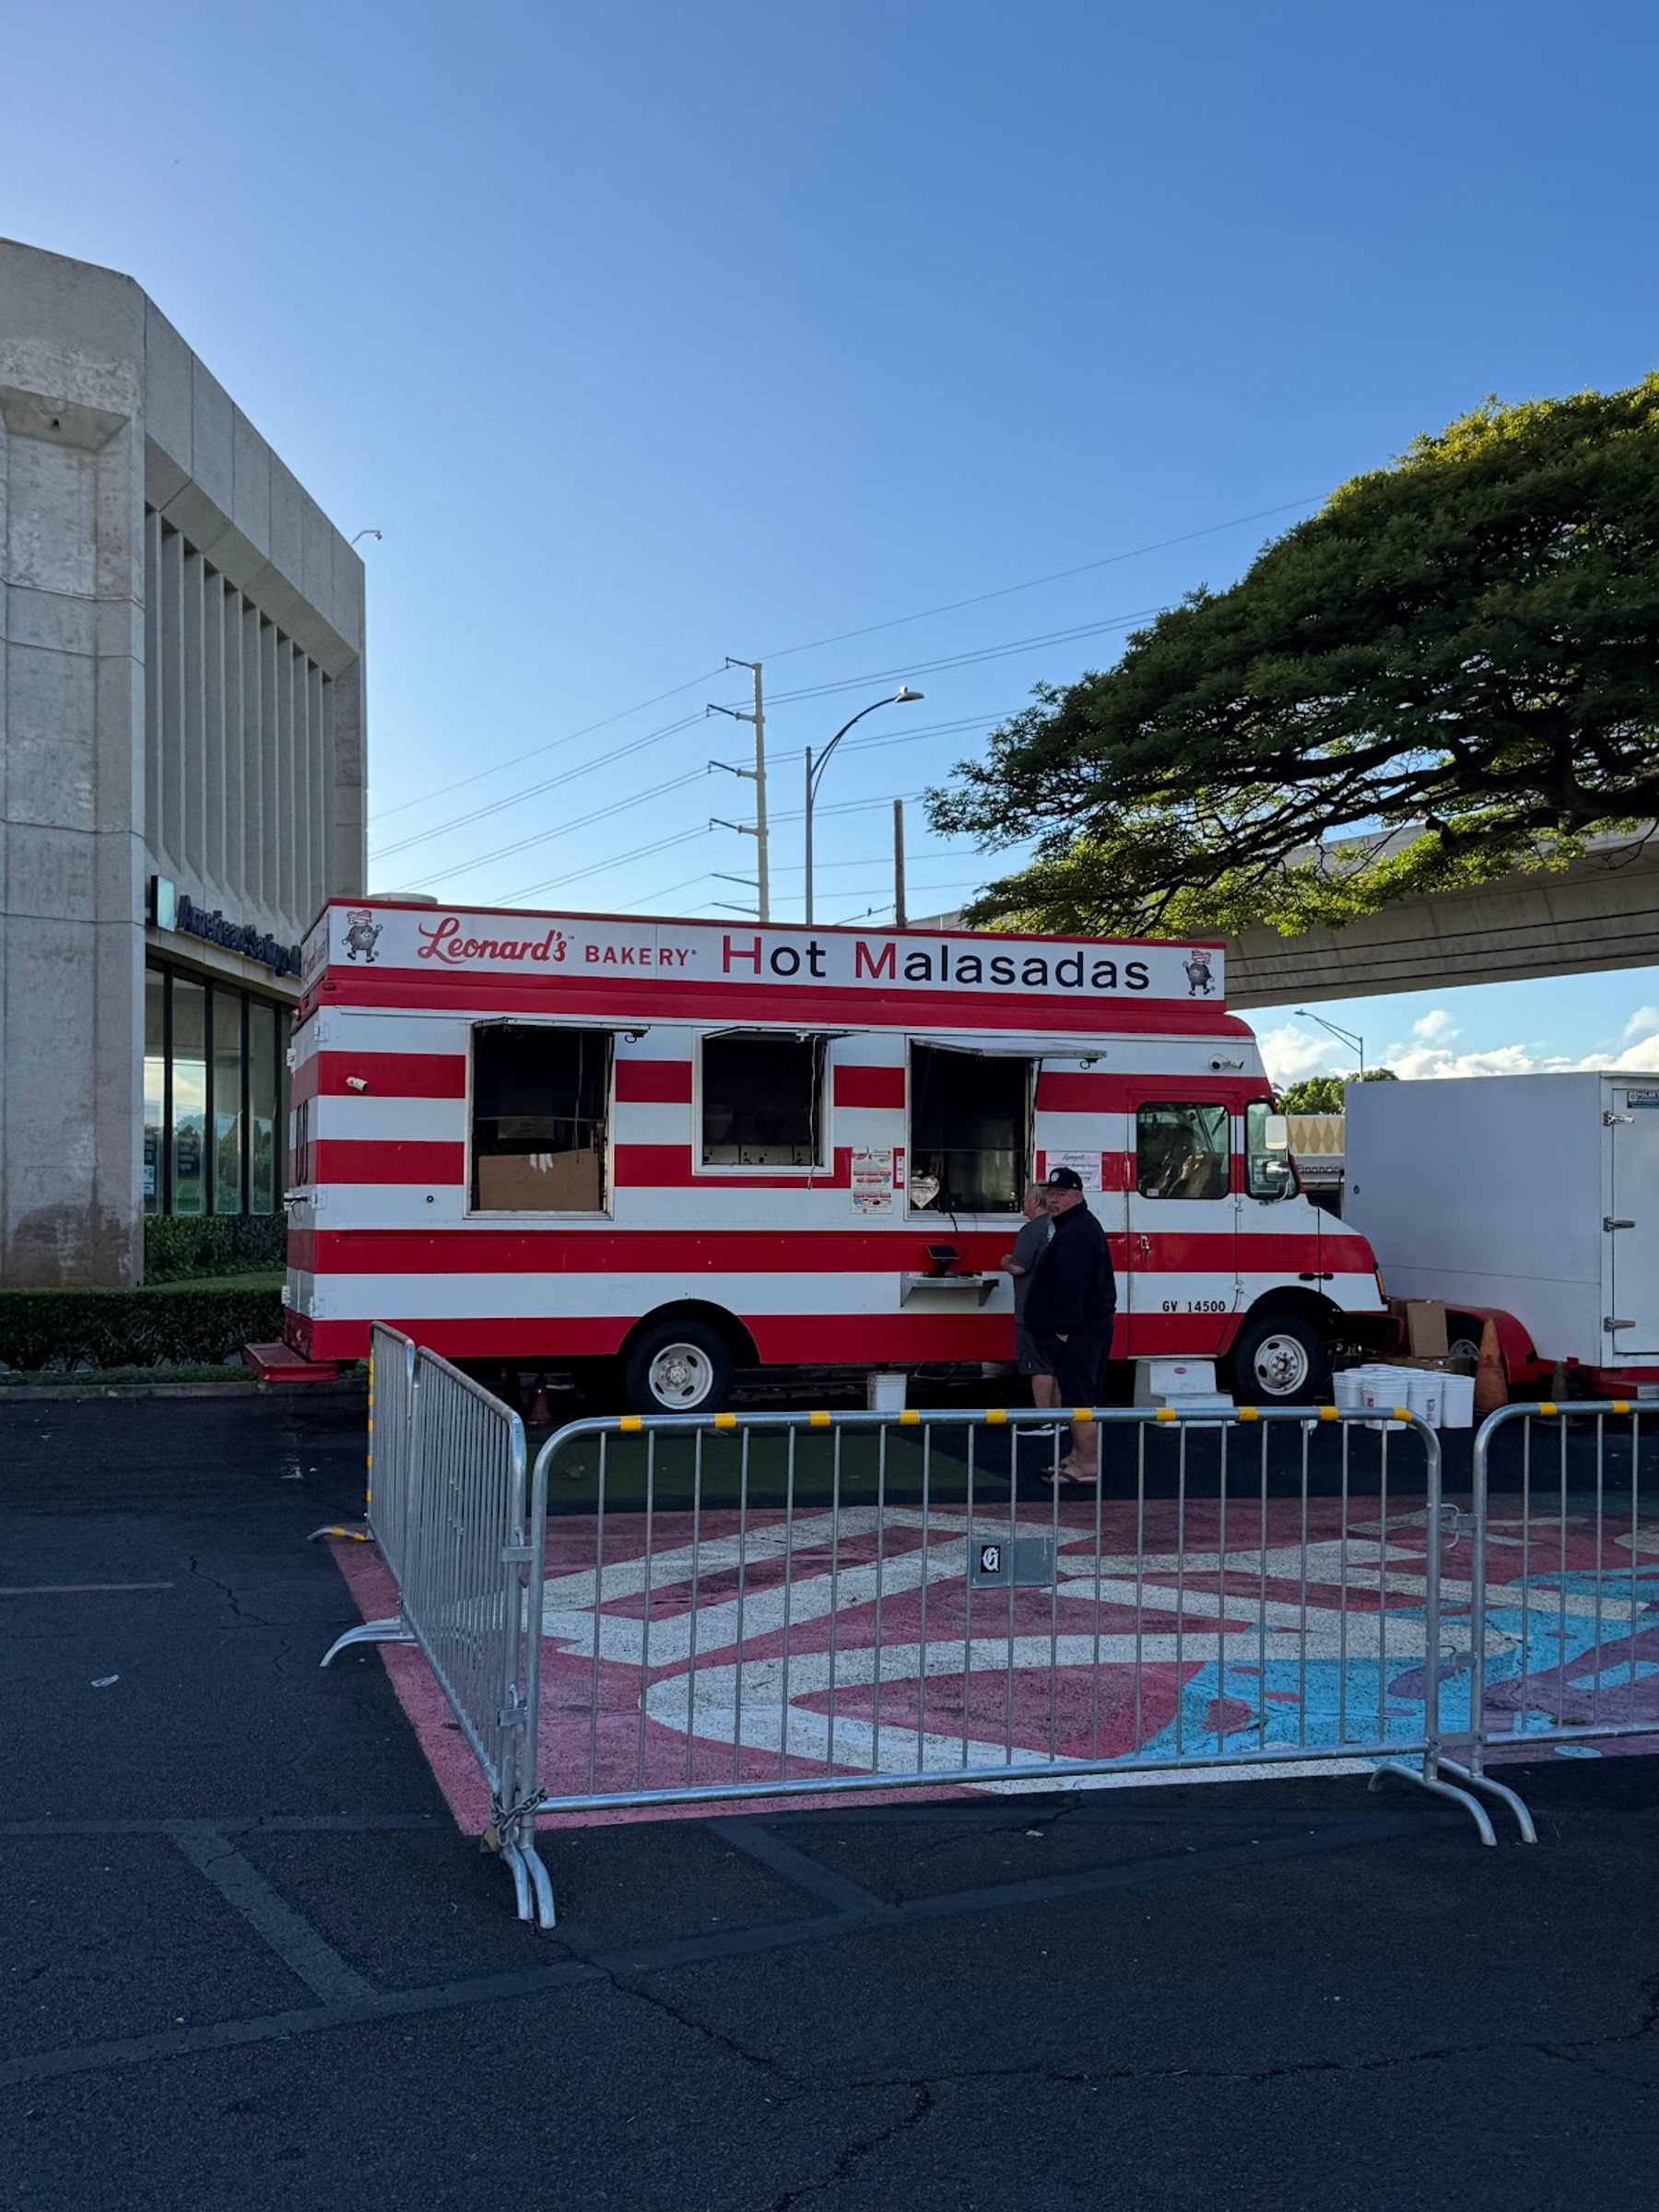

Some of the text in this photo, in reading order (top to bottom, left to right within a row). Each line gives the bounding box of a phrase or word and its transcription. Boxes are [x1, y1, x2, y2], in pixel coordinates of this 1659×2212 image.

[418, 917, 689, 966] Leonard's BAKERY
[722, 935, 1150, 991] Hot Malasadas
[1162, 1300, 1226, 1312] GV 14500
